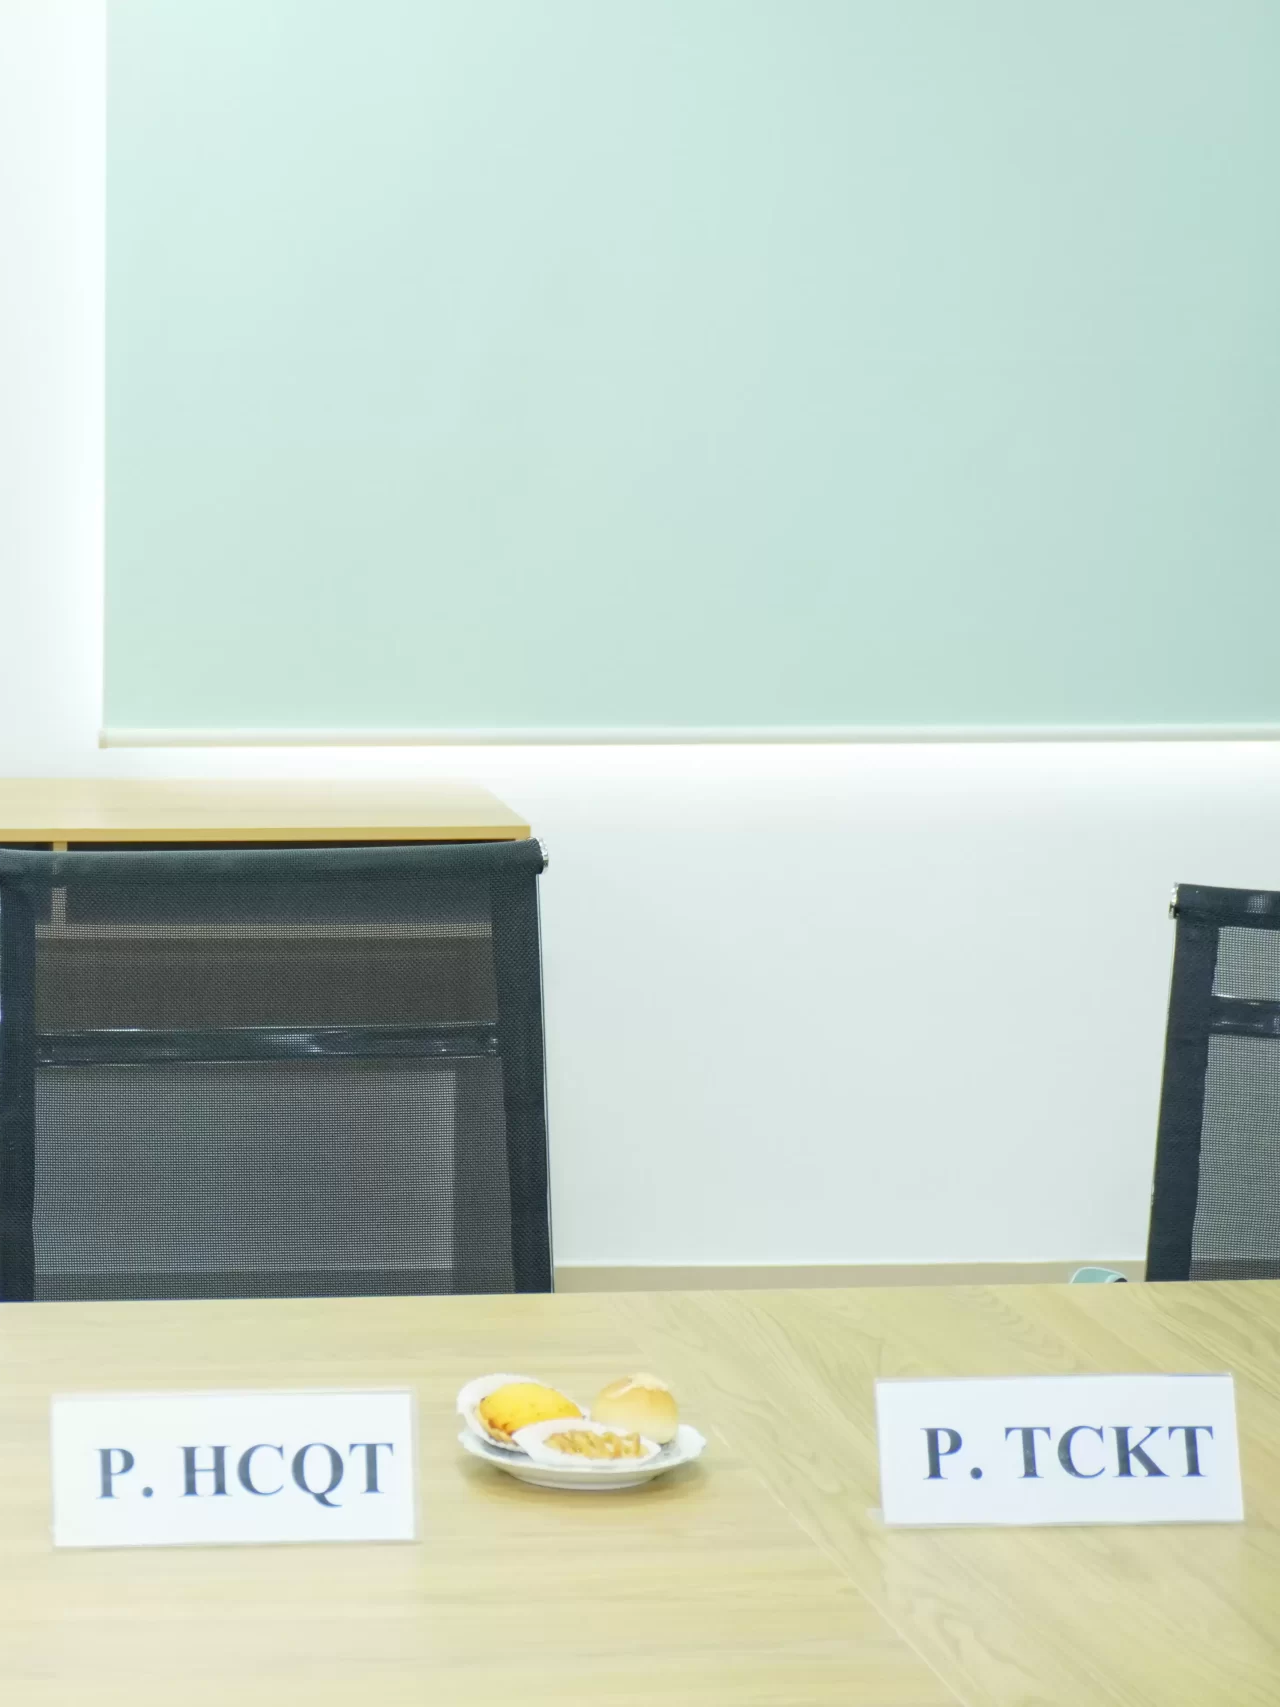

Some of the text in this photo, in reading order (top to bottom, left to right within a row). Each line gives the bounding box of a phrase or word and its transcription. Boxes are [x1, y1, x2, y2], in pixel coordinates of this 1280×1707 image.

[97, 1442, 395, 1508] P. HCQT
[922, 1425, 1216, 1482] P. TCKT
